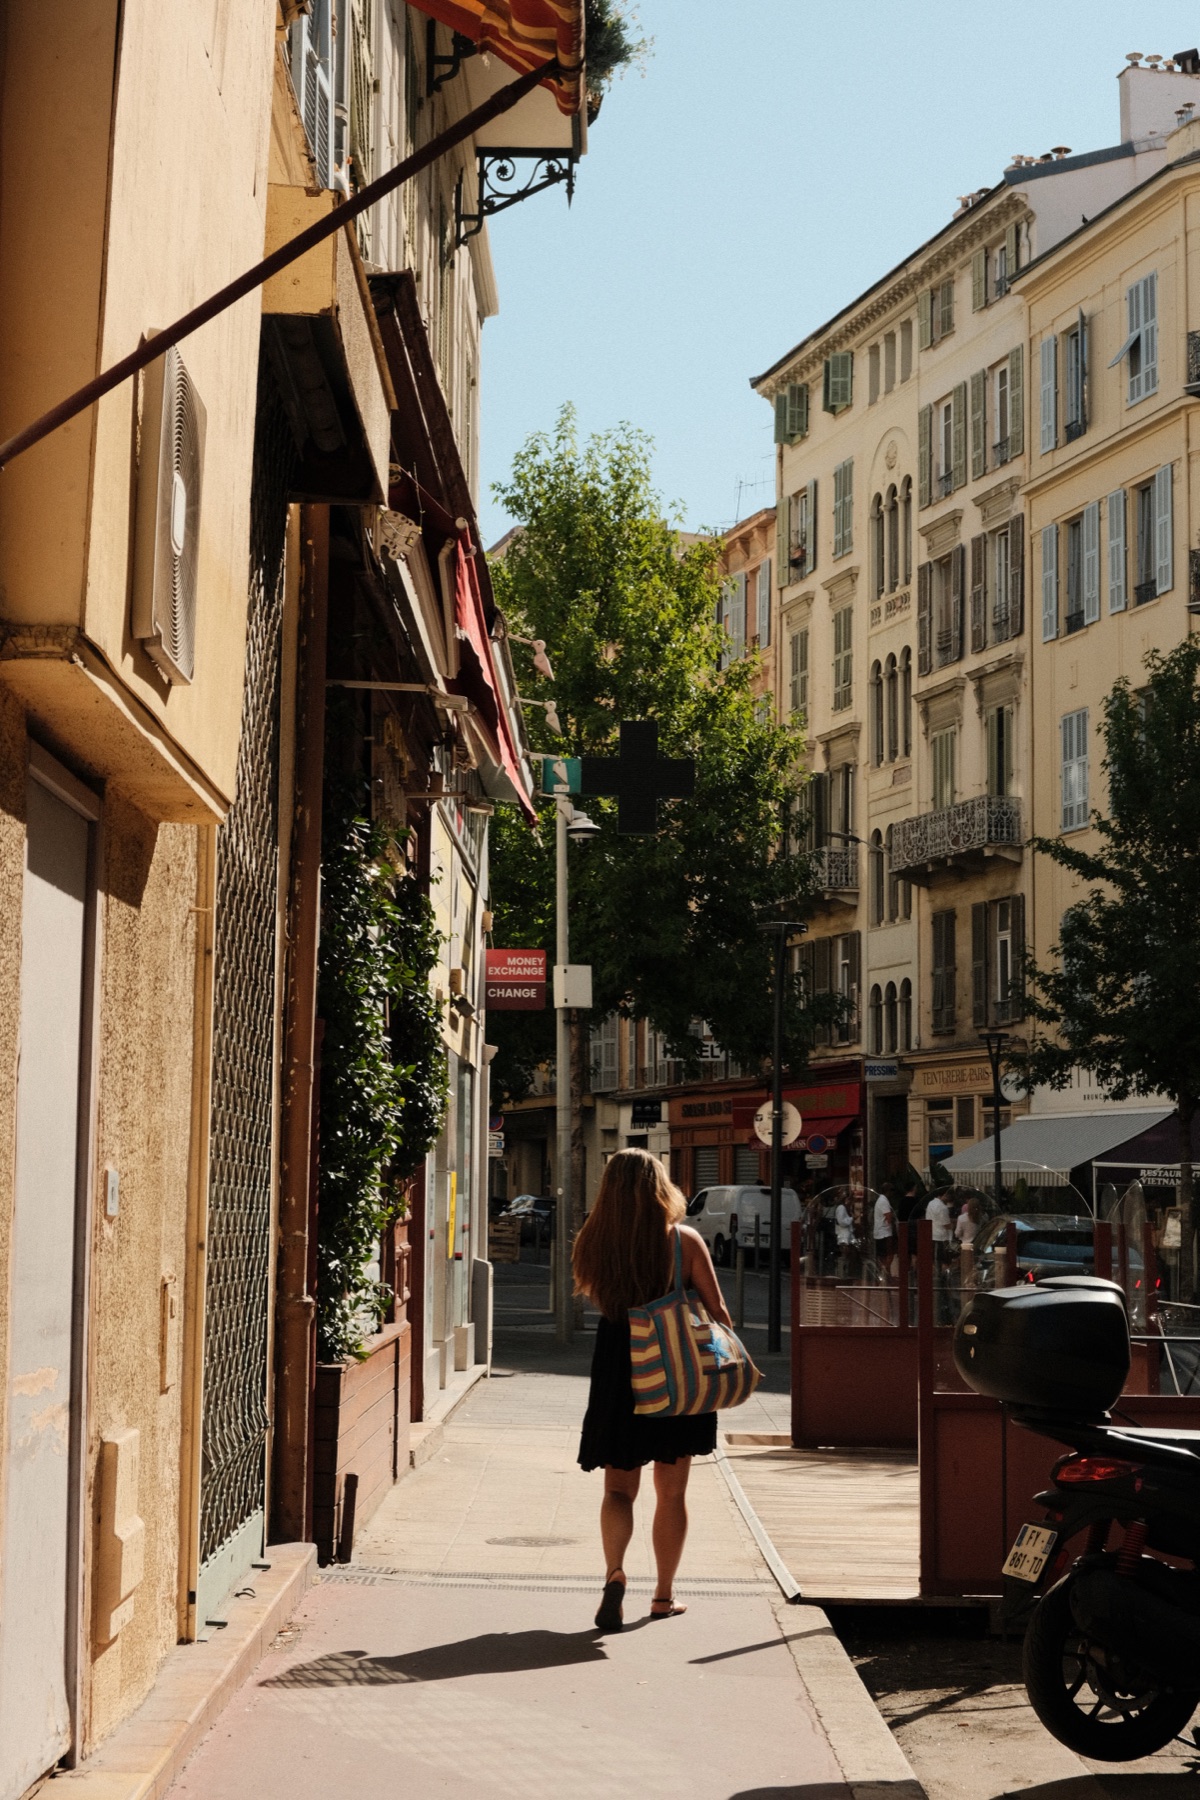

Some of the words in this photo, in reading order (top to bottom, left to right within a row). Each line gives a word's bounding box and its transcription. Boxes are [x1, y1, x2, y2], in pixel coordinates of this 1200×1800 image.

[507, 957, 544, 966] MONEY
[488, 967, 544, 976] EXCHANGE
[487, 988, 537, 998] CHANGE
[865, 1065, 897, 1077] PRESSING
